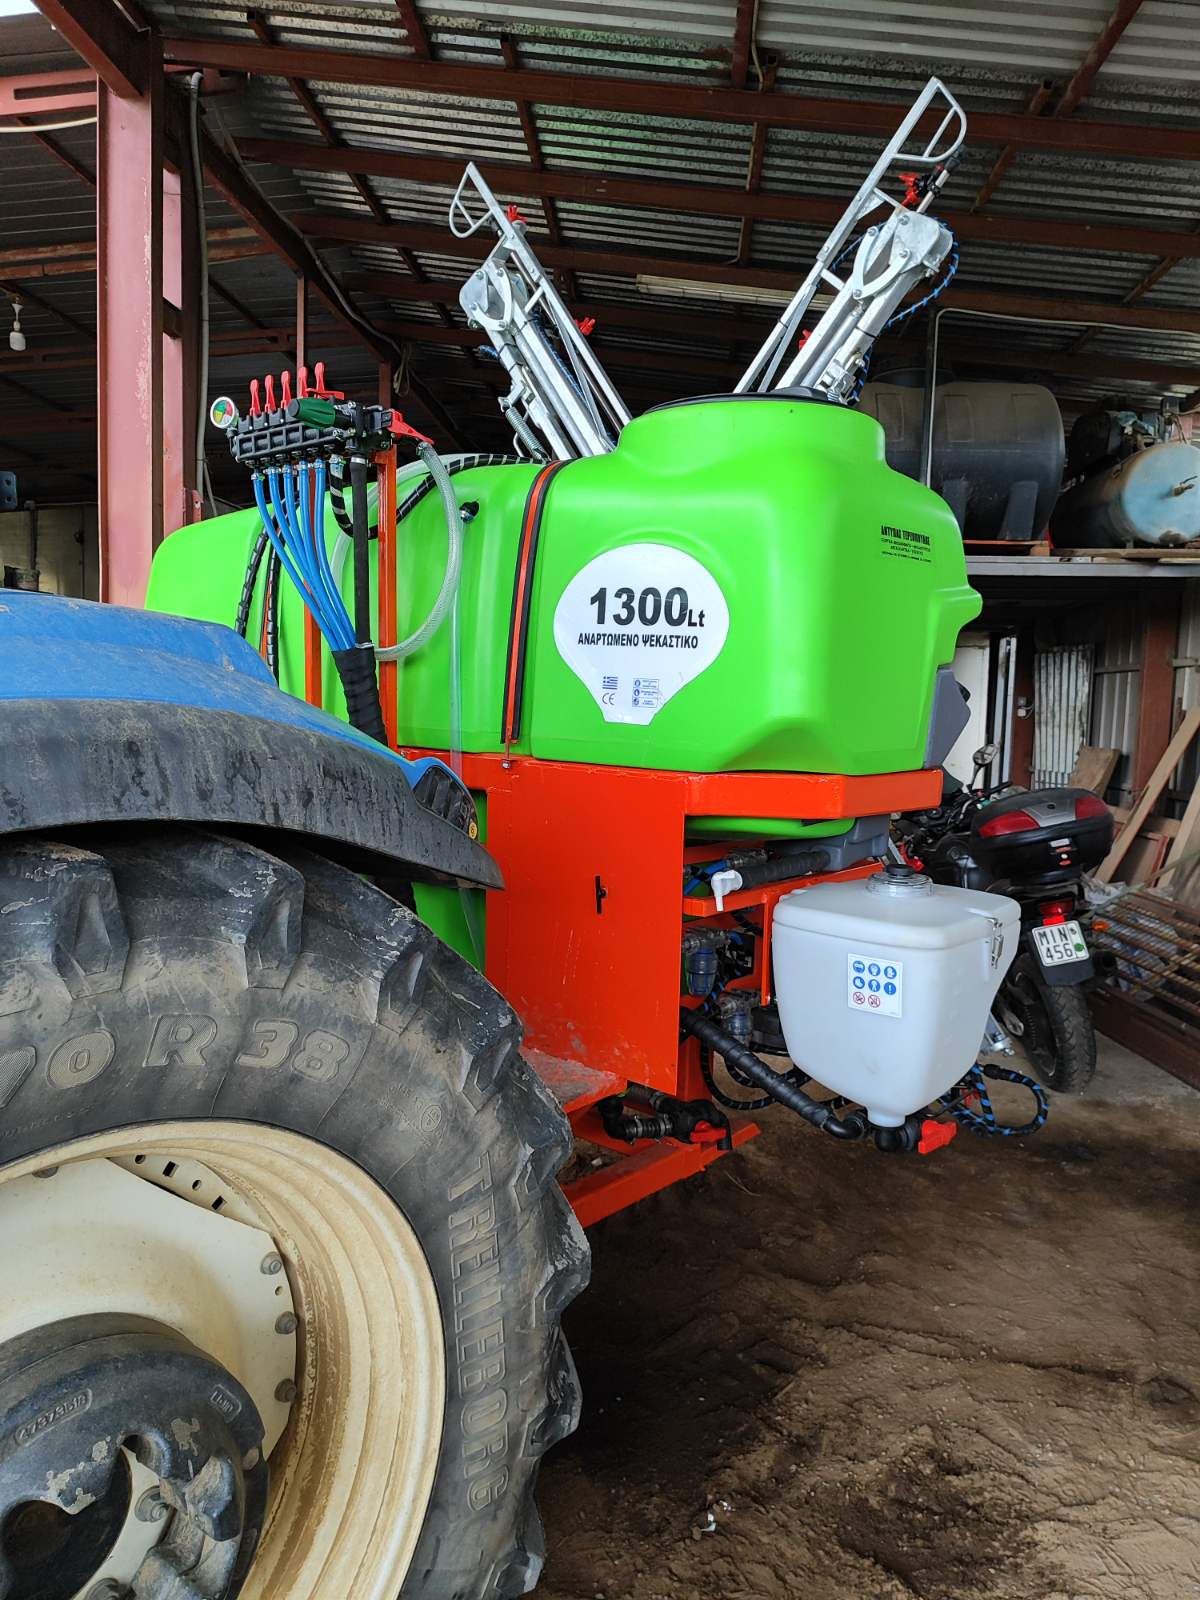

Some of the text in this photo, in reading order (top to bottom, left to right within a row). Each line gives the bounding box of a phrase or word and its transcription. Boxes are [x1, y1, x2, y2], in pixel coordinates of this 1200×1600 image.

[578, 632, 698, 649] ΑΝΑΡΤΩΜΕΝΟ ΨΕΚΑΣΤΙΚΟ
[1037, 926, 1068, 946] MIN
[1045, 943, 1073, 961] 456
[235, 1018, 350, 1082] 38
[449, 1151, 509, 1512] TRELLEBORG
